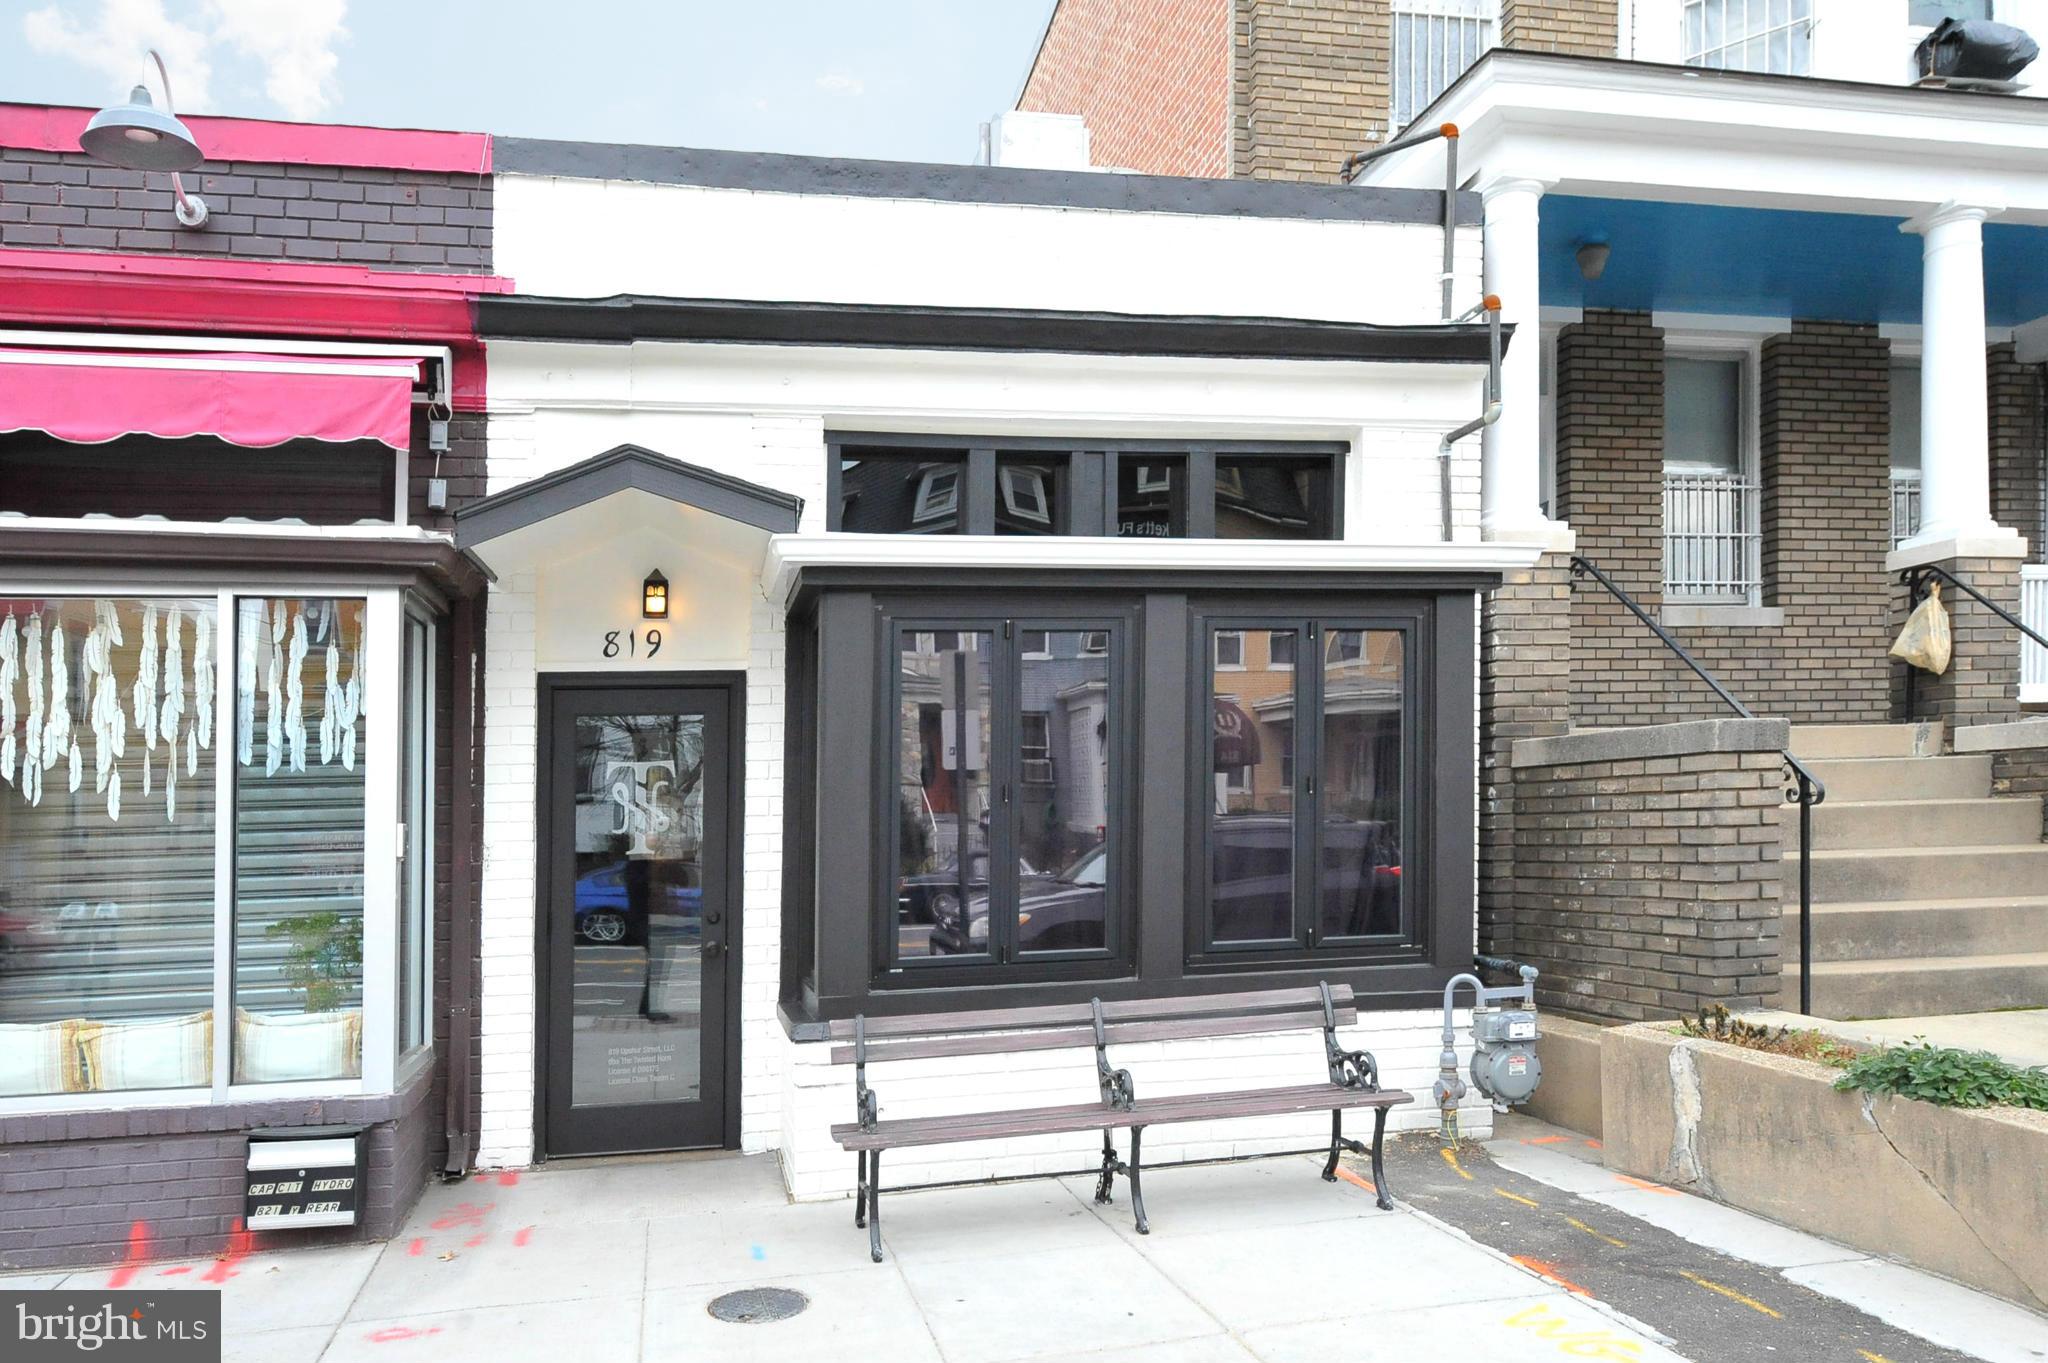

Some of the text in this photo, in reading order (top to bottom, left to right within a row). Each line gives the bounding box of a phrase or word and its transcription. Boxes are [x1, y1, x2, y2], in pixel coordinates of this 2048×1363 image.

[602, 629, 662, 659] 819
[250, 1179, 353, 1194] CAP CIT HYDRO
[256, 1206, 280, 1216] 821
[307, 1203, 338, 1213] REAR
